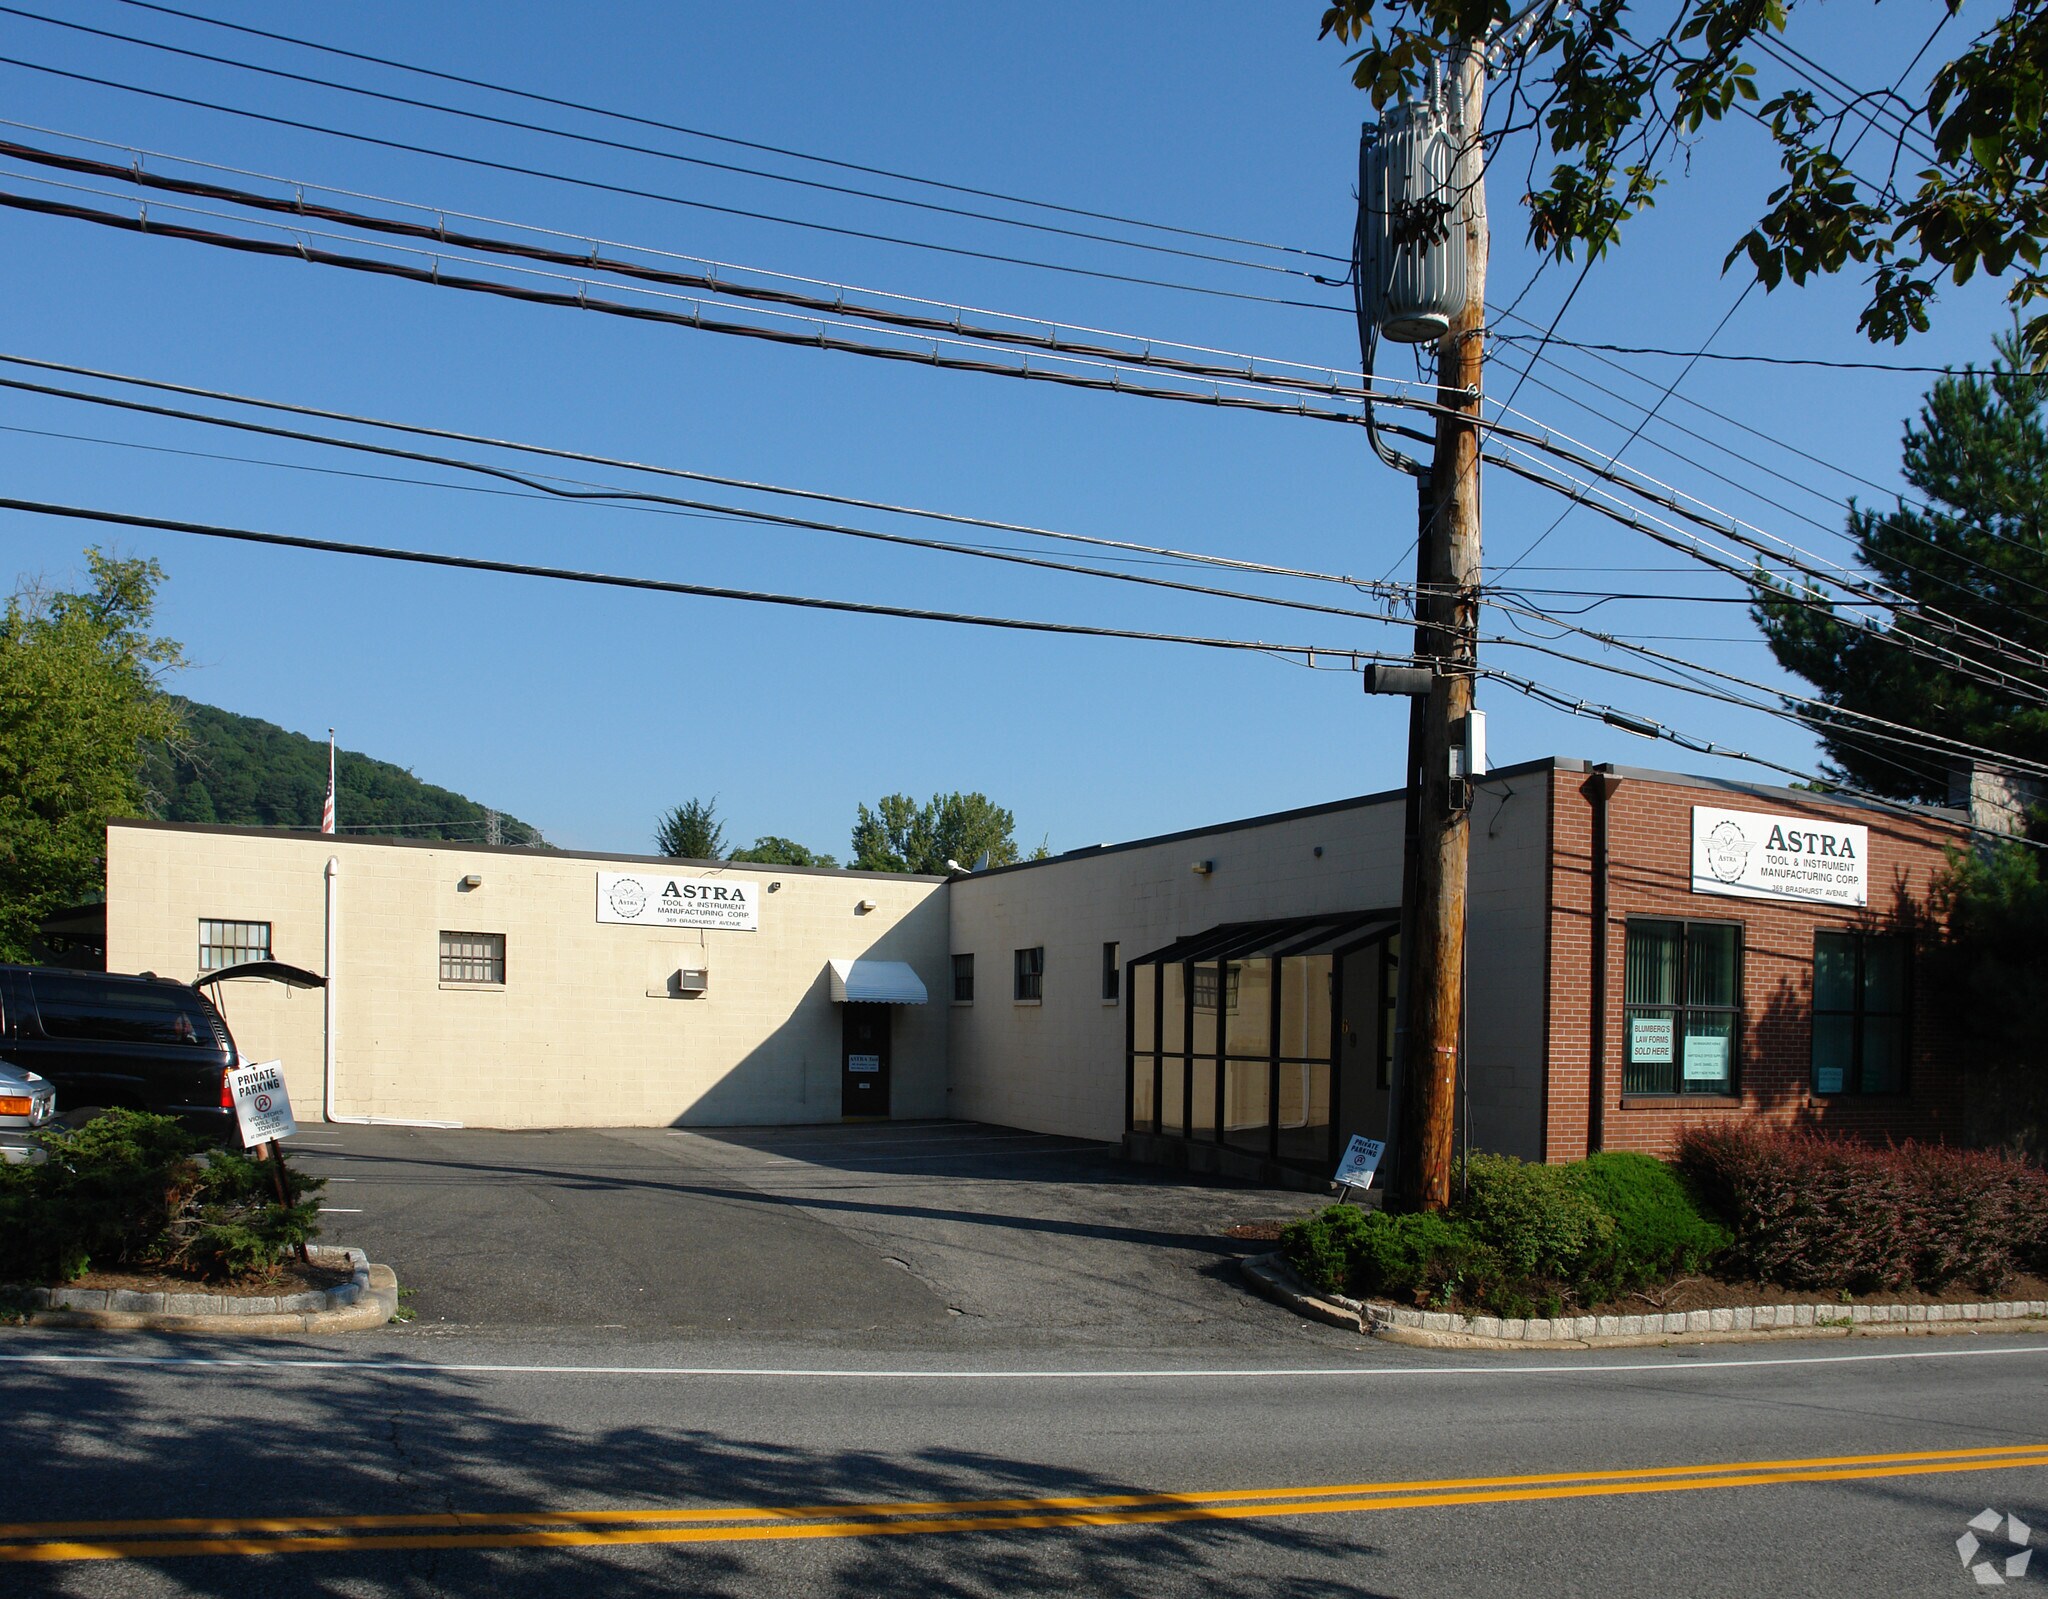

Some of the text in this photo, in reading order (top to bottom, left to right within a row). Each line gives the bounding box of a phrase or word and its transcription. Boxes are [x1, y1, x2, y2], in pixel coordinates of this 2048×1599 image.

[1765, 824, 1855, 858] ASTRA
[1718, 854, 1737, 863] ASTRA
[1766, 855, 1855, 872] TOOL & INSTRUMENT
[1760, 867, 1859, 885] MANUFACTURING CORP.
[661, 881, 746, 902] ASTRA
[1785, 886, 1823, 896] BRADHURST
[1825, 889, 1849, 898] AVENUE
[618, 898, 638, 906] ASTRA
[662, 899, 683, 907] TOOL
[697, 902, 746, 910] INSTRUMENT
[657, 907, 724, 917] MANUFACTURING
[1635, 1025, 1670, 1033] BLUMBERG'S
[1635, 1047, 1669, 1055] SOLD HERE
[237, 1068, 276, 1086] PRIVATE
[239, 1079, 280, 1097] PARKING
[248, 1109, 284, 1122] VIOLATORS
[254, 1115, 280, 1127] WILL BE
[257, 1122, 280, 1132] TOWED
[1354, 1138, 1379, 1150] PRIVATE
[1350, 1145, 1378, 1157] PARKING
